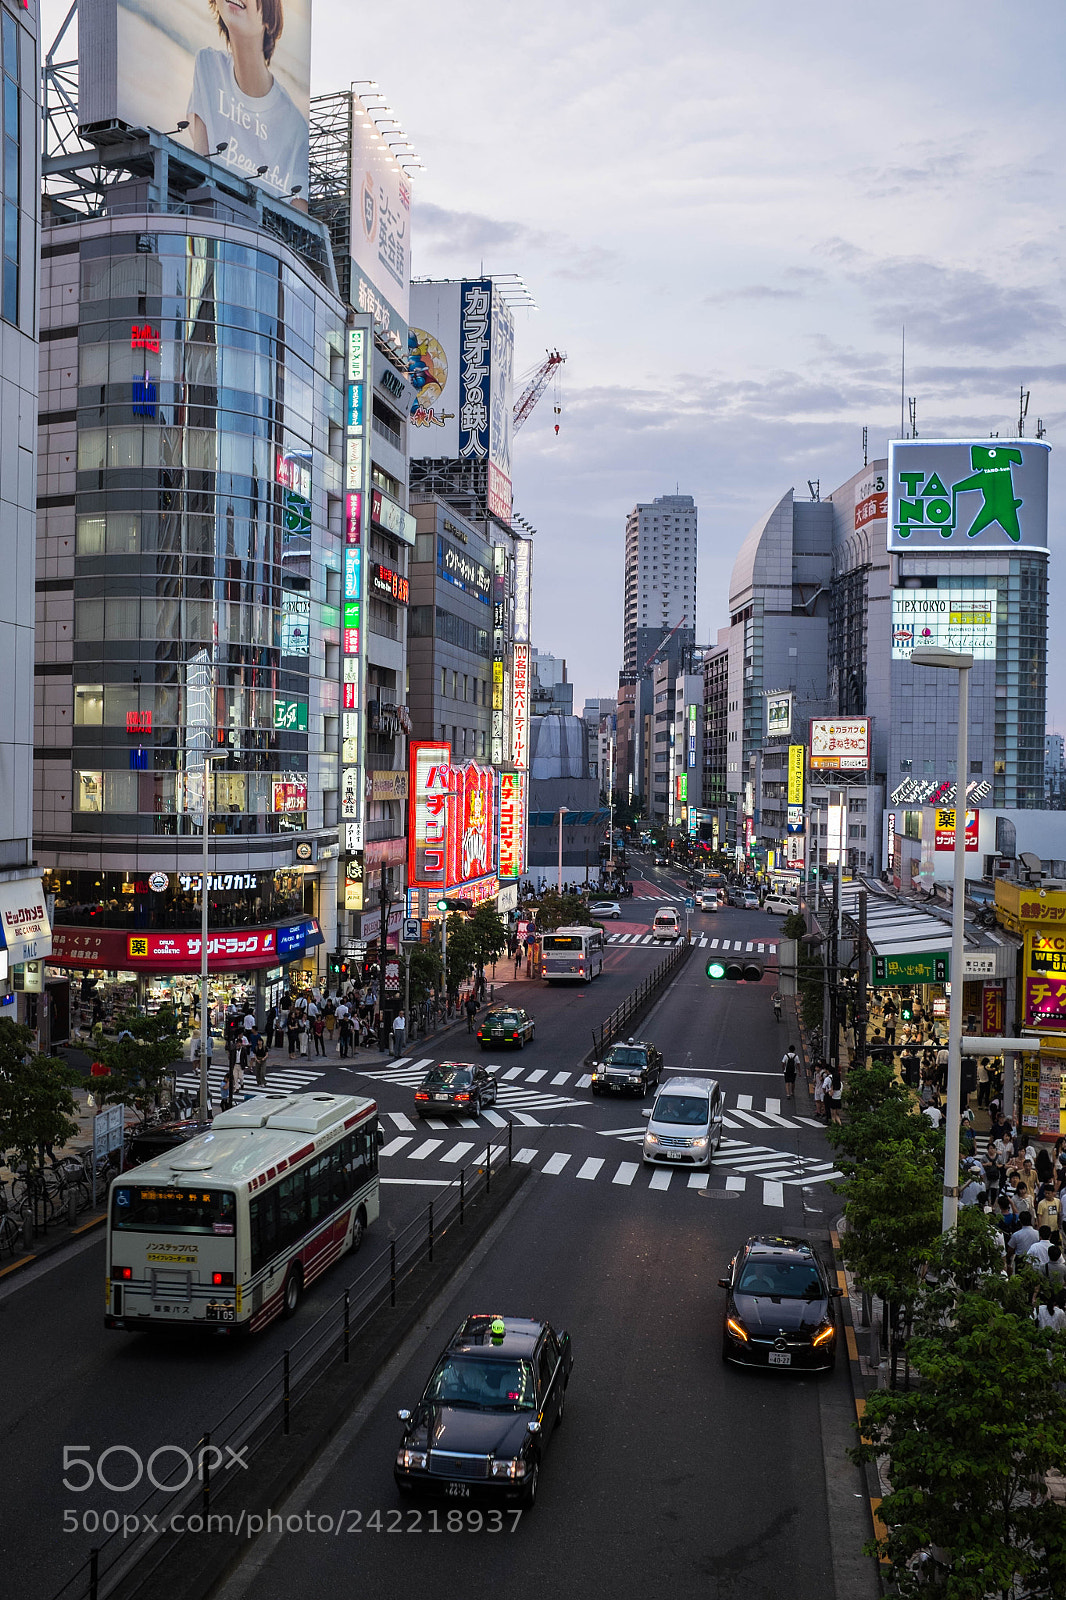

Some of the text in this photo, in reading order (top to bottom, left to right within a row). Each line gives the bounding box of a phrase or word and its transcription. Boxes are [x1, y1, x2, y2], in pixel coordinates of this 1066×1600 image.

[218, 88, 268, 140] Life is
[461, 287, 490, 458] カラオケの鉄人
[515, 540, 530, 640] カラオケの鉄人
[918, 601, 946, 612] TOKYO
[835, 726, 859, 734] カラオケ
[828, 737, 866, 750] まねきねこ
[424, 764, 450, 872] パチンコ
[938, 811, 956, 828] 薬
[180, 873, 257, 892] サンマルクカフェ
[5, 905, 44, 926] ビックカメラ
[14, 924, 41, 937] BIC CAMERA
[131, 939, 146, 955] 薬
[187, 937, 258, 955] サンドラッグ
[888, 961, 932, 977] 思い出横丁
[986, 991, 995, 1029] チケット
[146, 1243, 199, 1253] ノンステップバス
